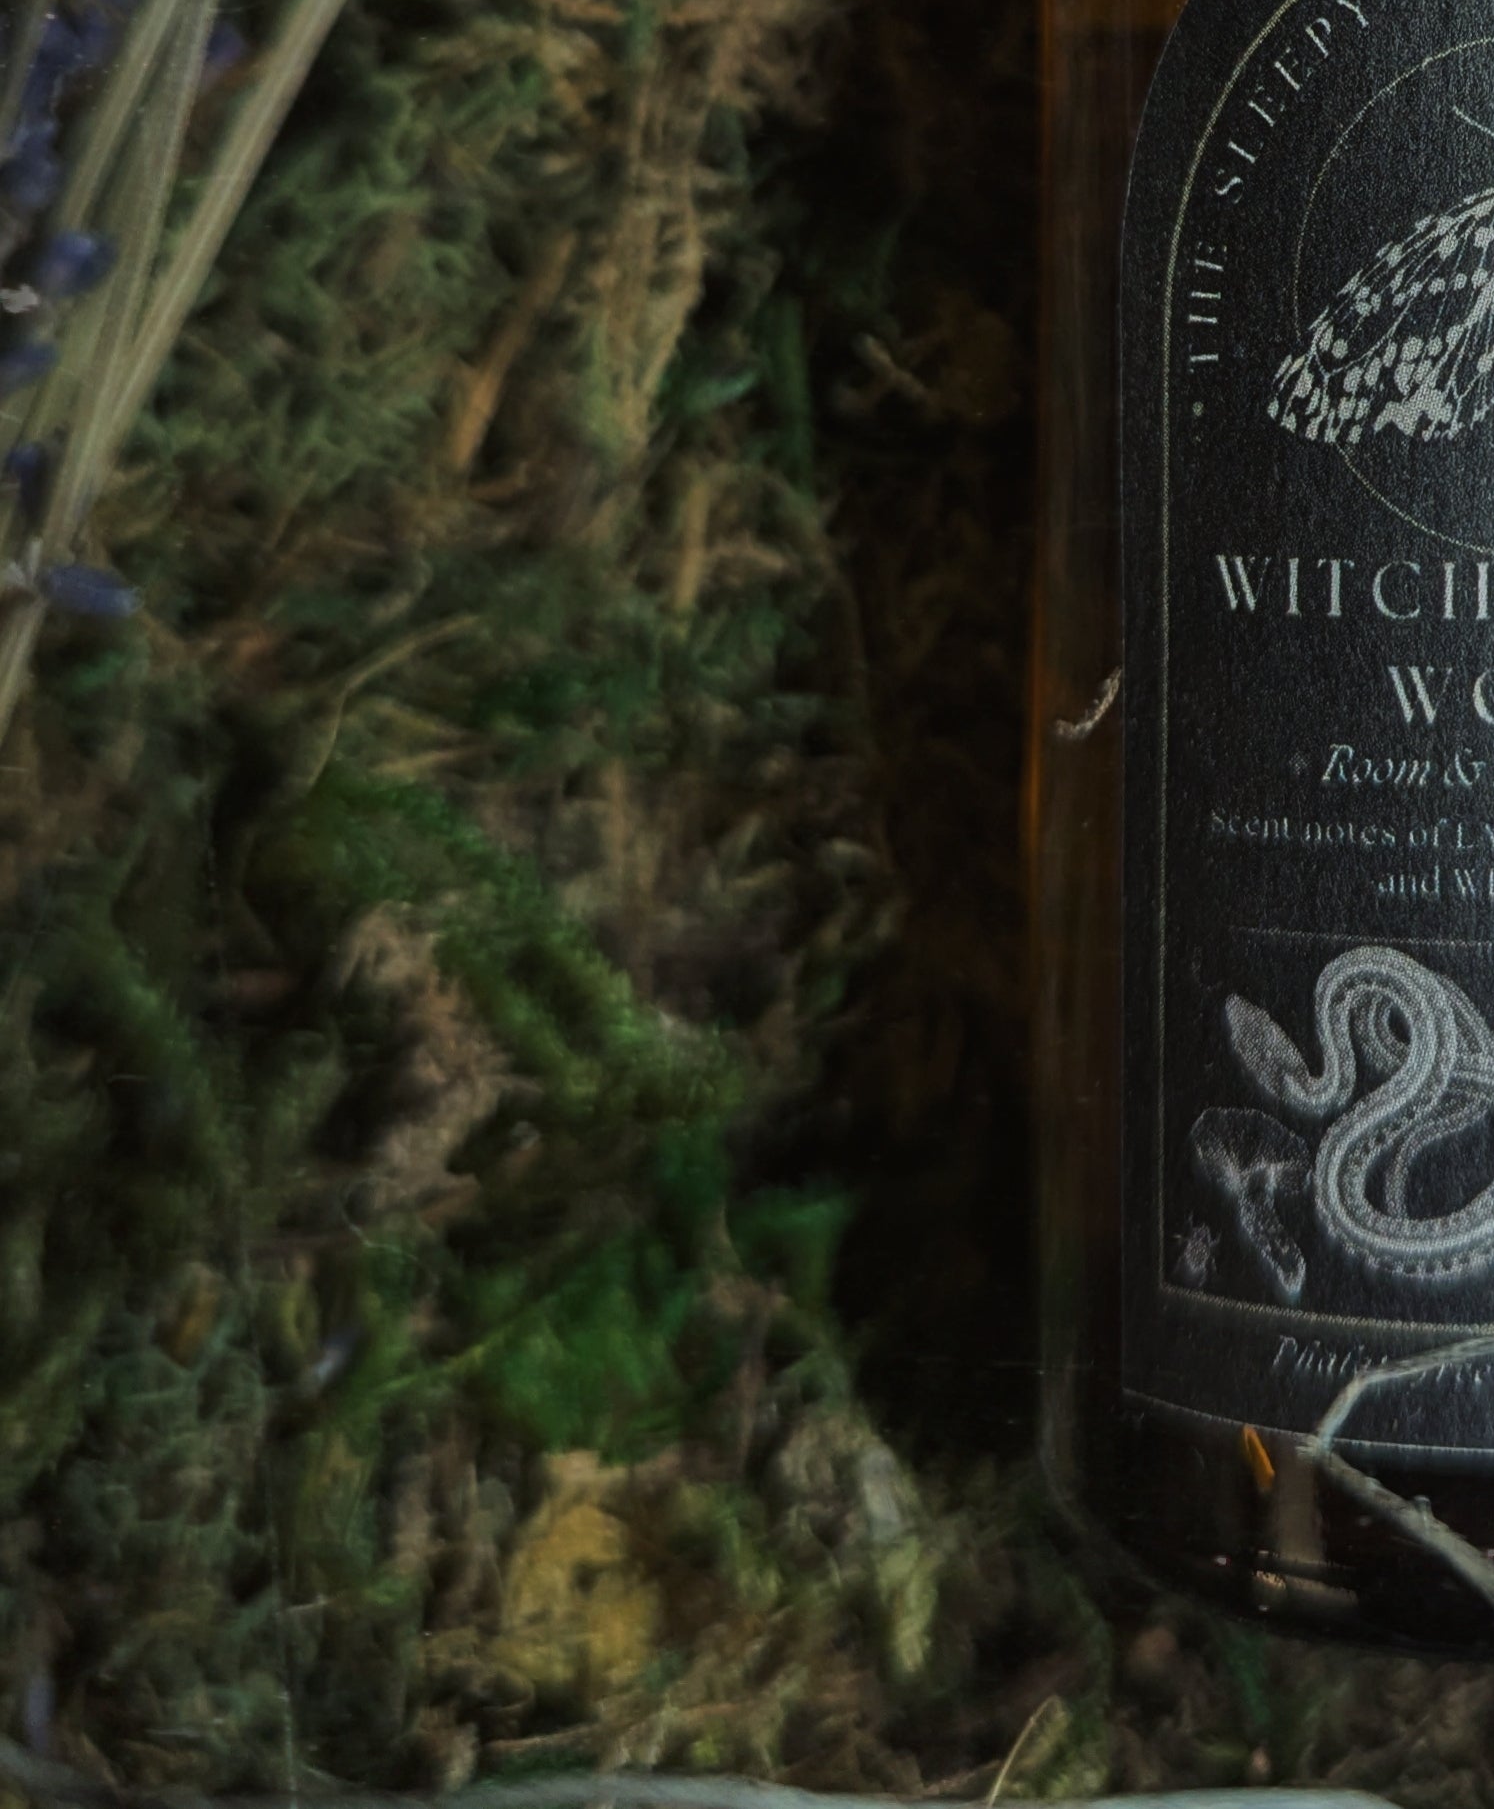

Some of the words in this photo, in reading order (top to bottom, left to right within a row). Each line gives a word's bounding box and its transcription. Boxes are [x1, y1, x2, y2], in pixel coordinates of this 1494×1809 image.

[1187, 240, 1229, 373] THE
[1216, 554, 1490, 620] WITCH
[1321, 744, 1432, 787] Room
[1443, 747, 1486, 787] &
[1210, 808, 1290, 840] Scent
[1303, 821, 1397, 845] notes
[1409, 817, 1448, 847] of
[1376, 865, 1442, 897] and
